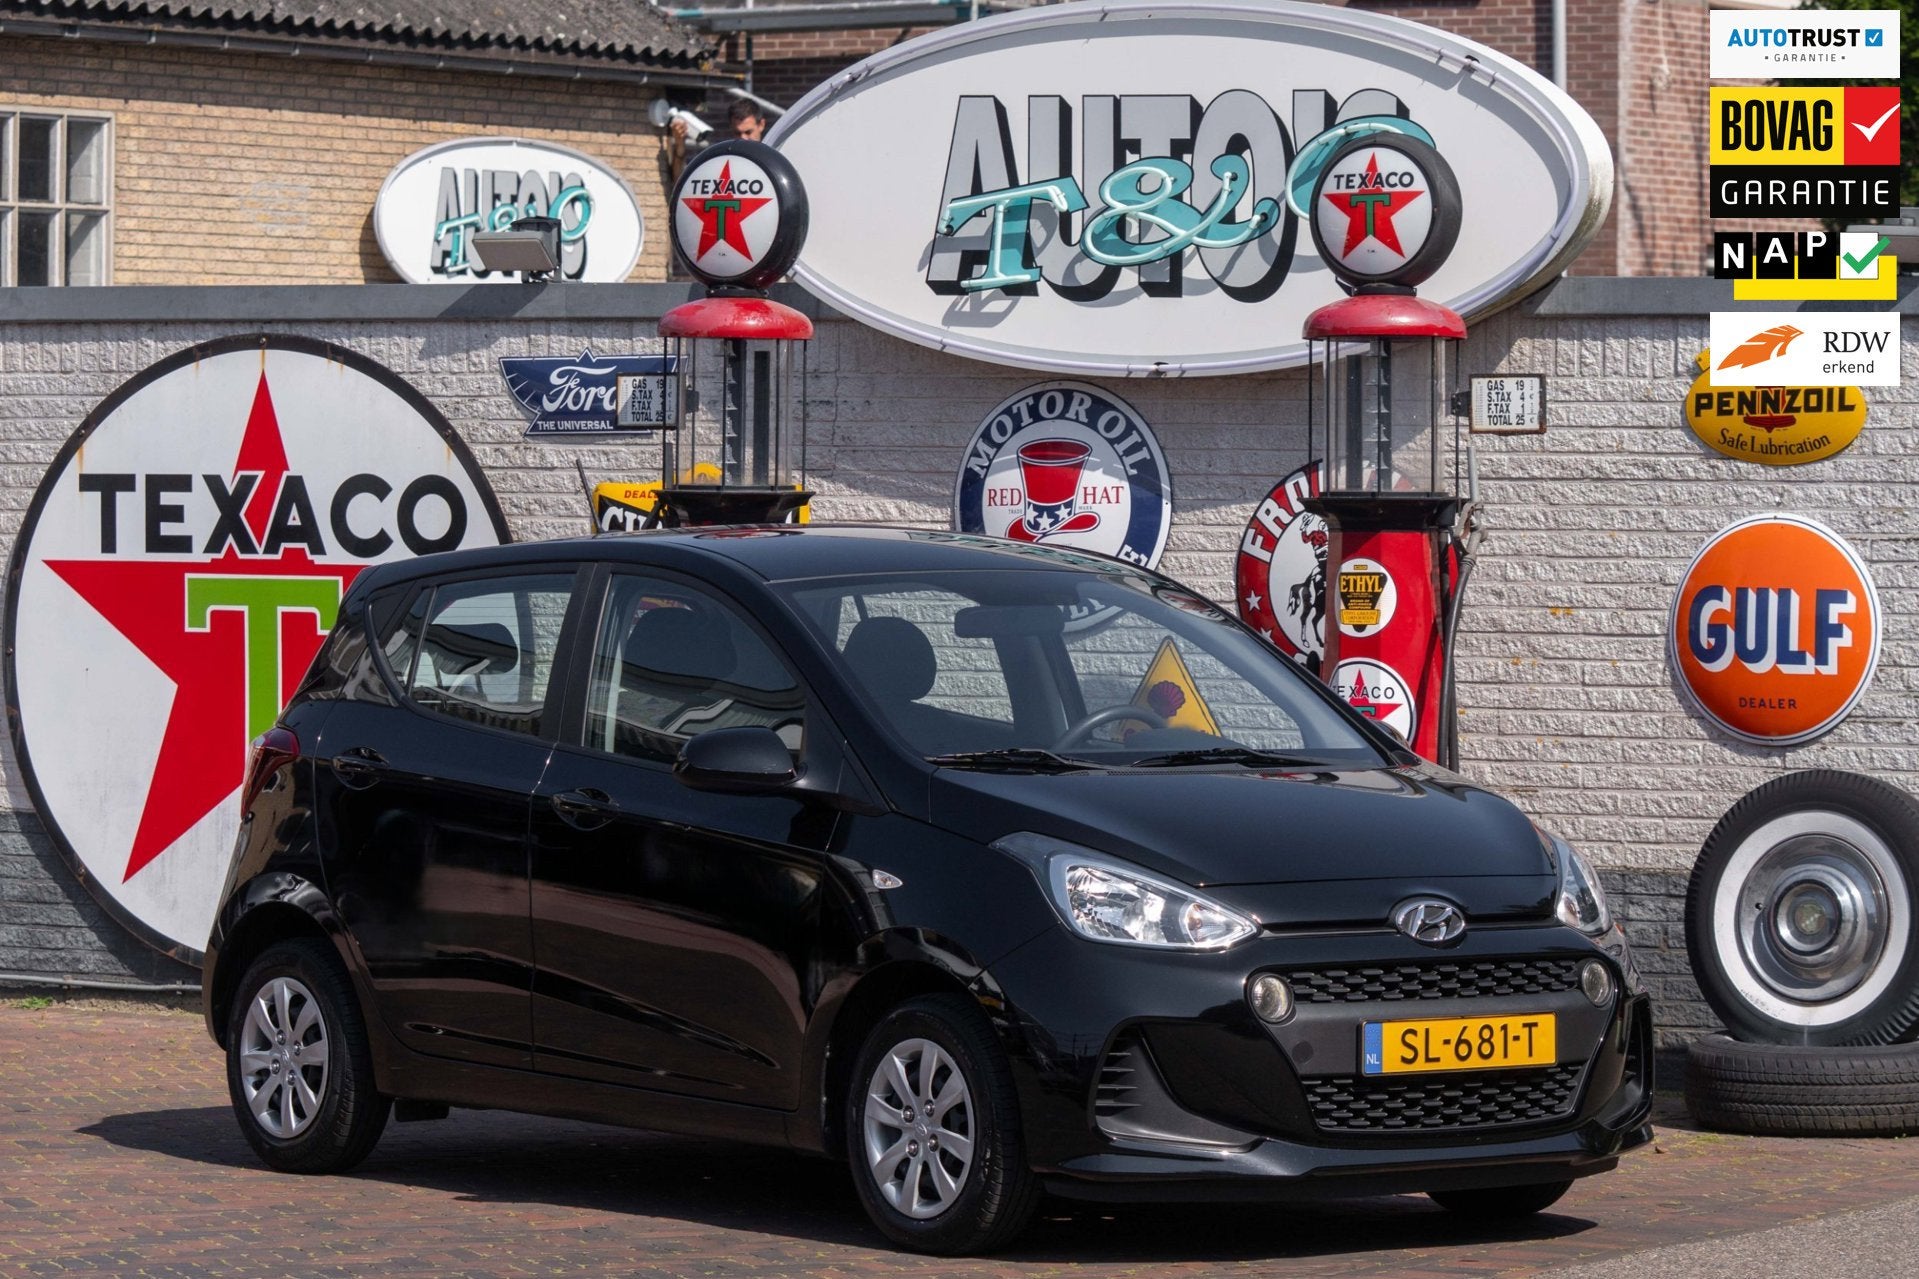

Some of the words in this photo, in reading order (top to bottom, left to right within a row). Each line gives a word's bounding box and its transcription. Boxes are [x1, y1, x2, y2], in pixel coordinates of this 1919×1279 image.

[690, 179, 764, 195] TEXACO
[1333, 171, 1415, 190] TEXACO
[631, 378, 648, 389] GAS
[1487, 380, 1505, 391] GAS
[1515, 380, 1525, 391] 19
[631, 390, 653, 401] S.TAX
[1487, 391, 1512, 403] S.TAX
[1519, 392, 1525, 402] 4
[1694, 387, 1856, 418] PENNZOIL
[631, 402, 651, 412] F.TAX
[1487, 403, 1510, 414] F.TAX
[1520, 403, 1525, 414] 1
[631, 411, 654, 422] TOTAL
[1487, 415, 1512, 426] TOTAL
[1515, 415, 1525, 426] 25
[537, 421, 556, 430] THE
[557, 420, 614, 431] UNIVERSAL
[966, 390, 1093, 480] MOTOR
[1096, 409, 1151, 477] OIL
[1717, 428, 1748, 449] Safe
[1750, 435, 1831, 456] Lubrication
[987, 487, 1023, 507] RED
[1082, 486, 1125, 505] HAT
[78, 473, 468, 559] TEXACO
[1341, 575, 1383, 593] ETHYL
[1689, 585, 1857, 676] GULF
[1738, 697, 1797, 709] DEALER
[1366, 1053, 1380, 1065] NL
[1400, 1021, 1539, 1066] SL-681-T
